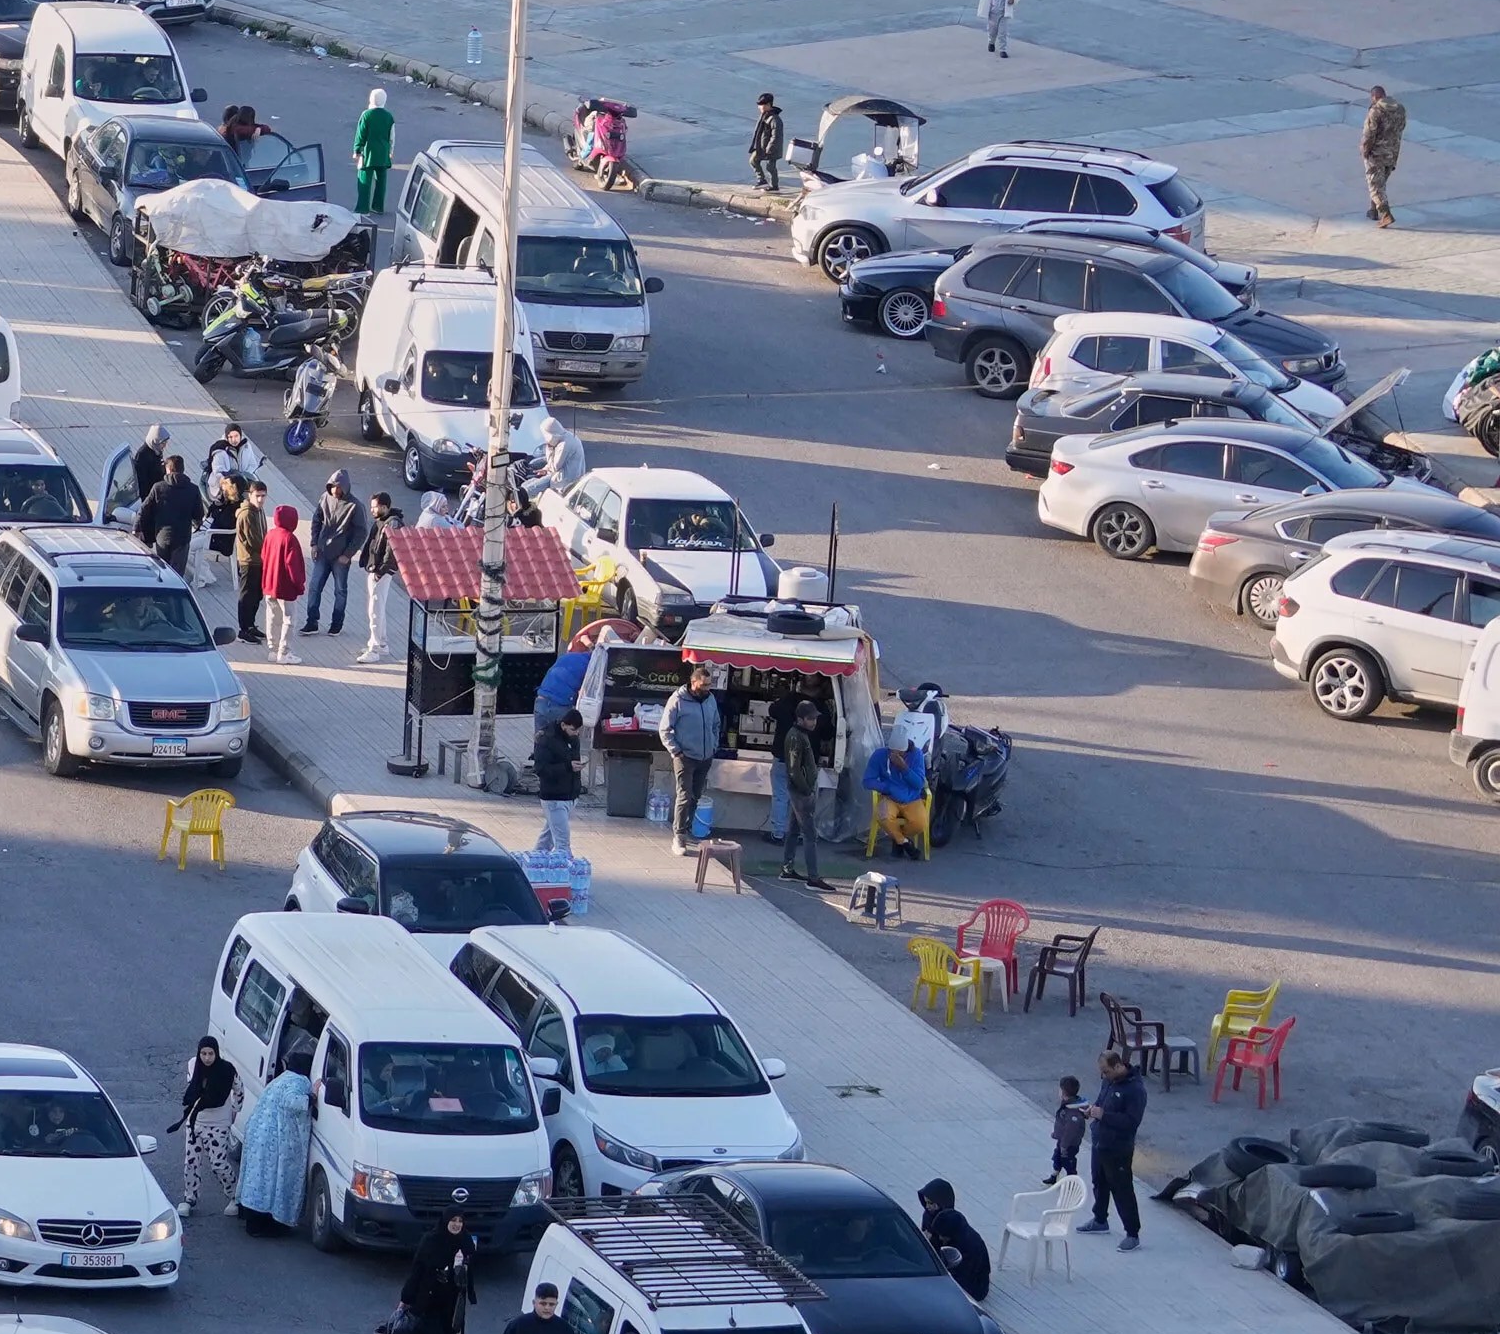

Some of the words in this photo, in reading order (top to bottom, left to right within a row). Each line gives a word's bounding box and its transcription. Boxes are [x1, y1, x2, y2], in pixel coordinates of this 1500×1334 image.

[648, 670, 680, 683] Café
[151, 709, 188, 721] GMC
[82, 1255, 118, 1266] 353981
